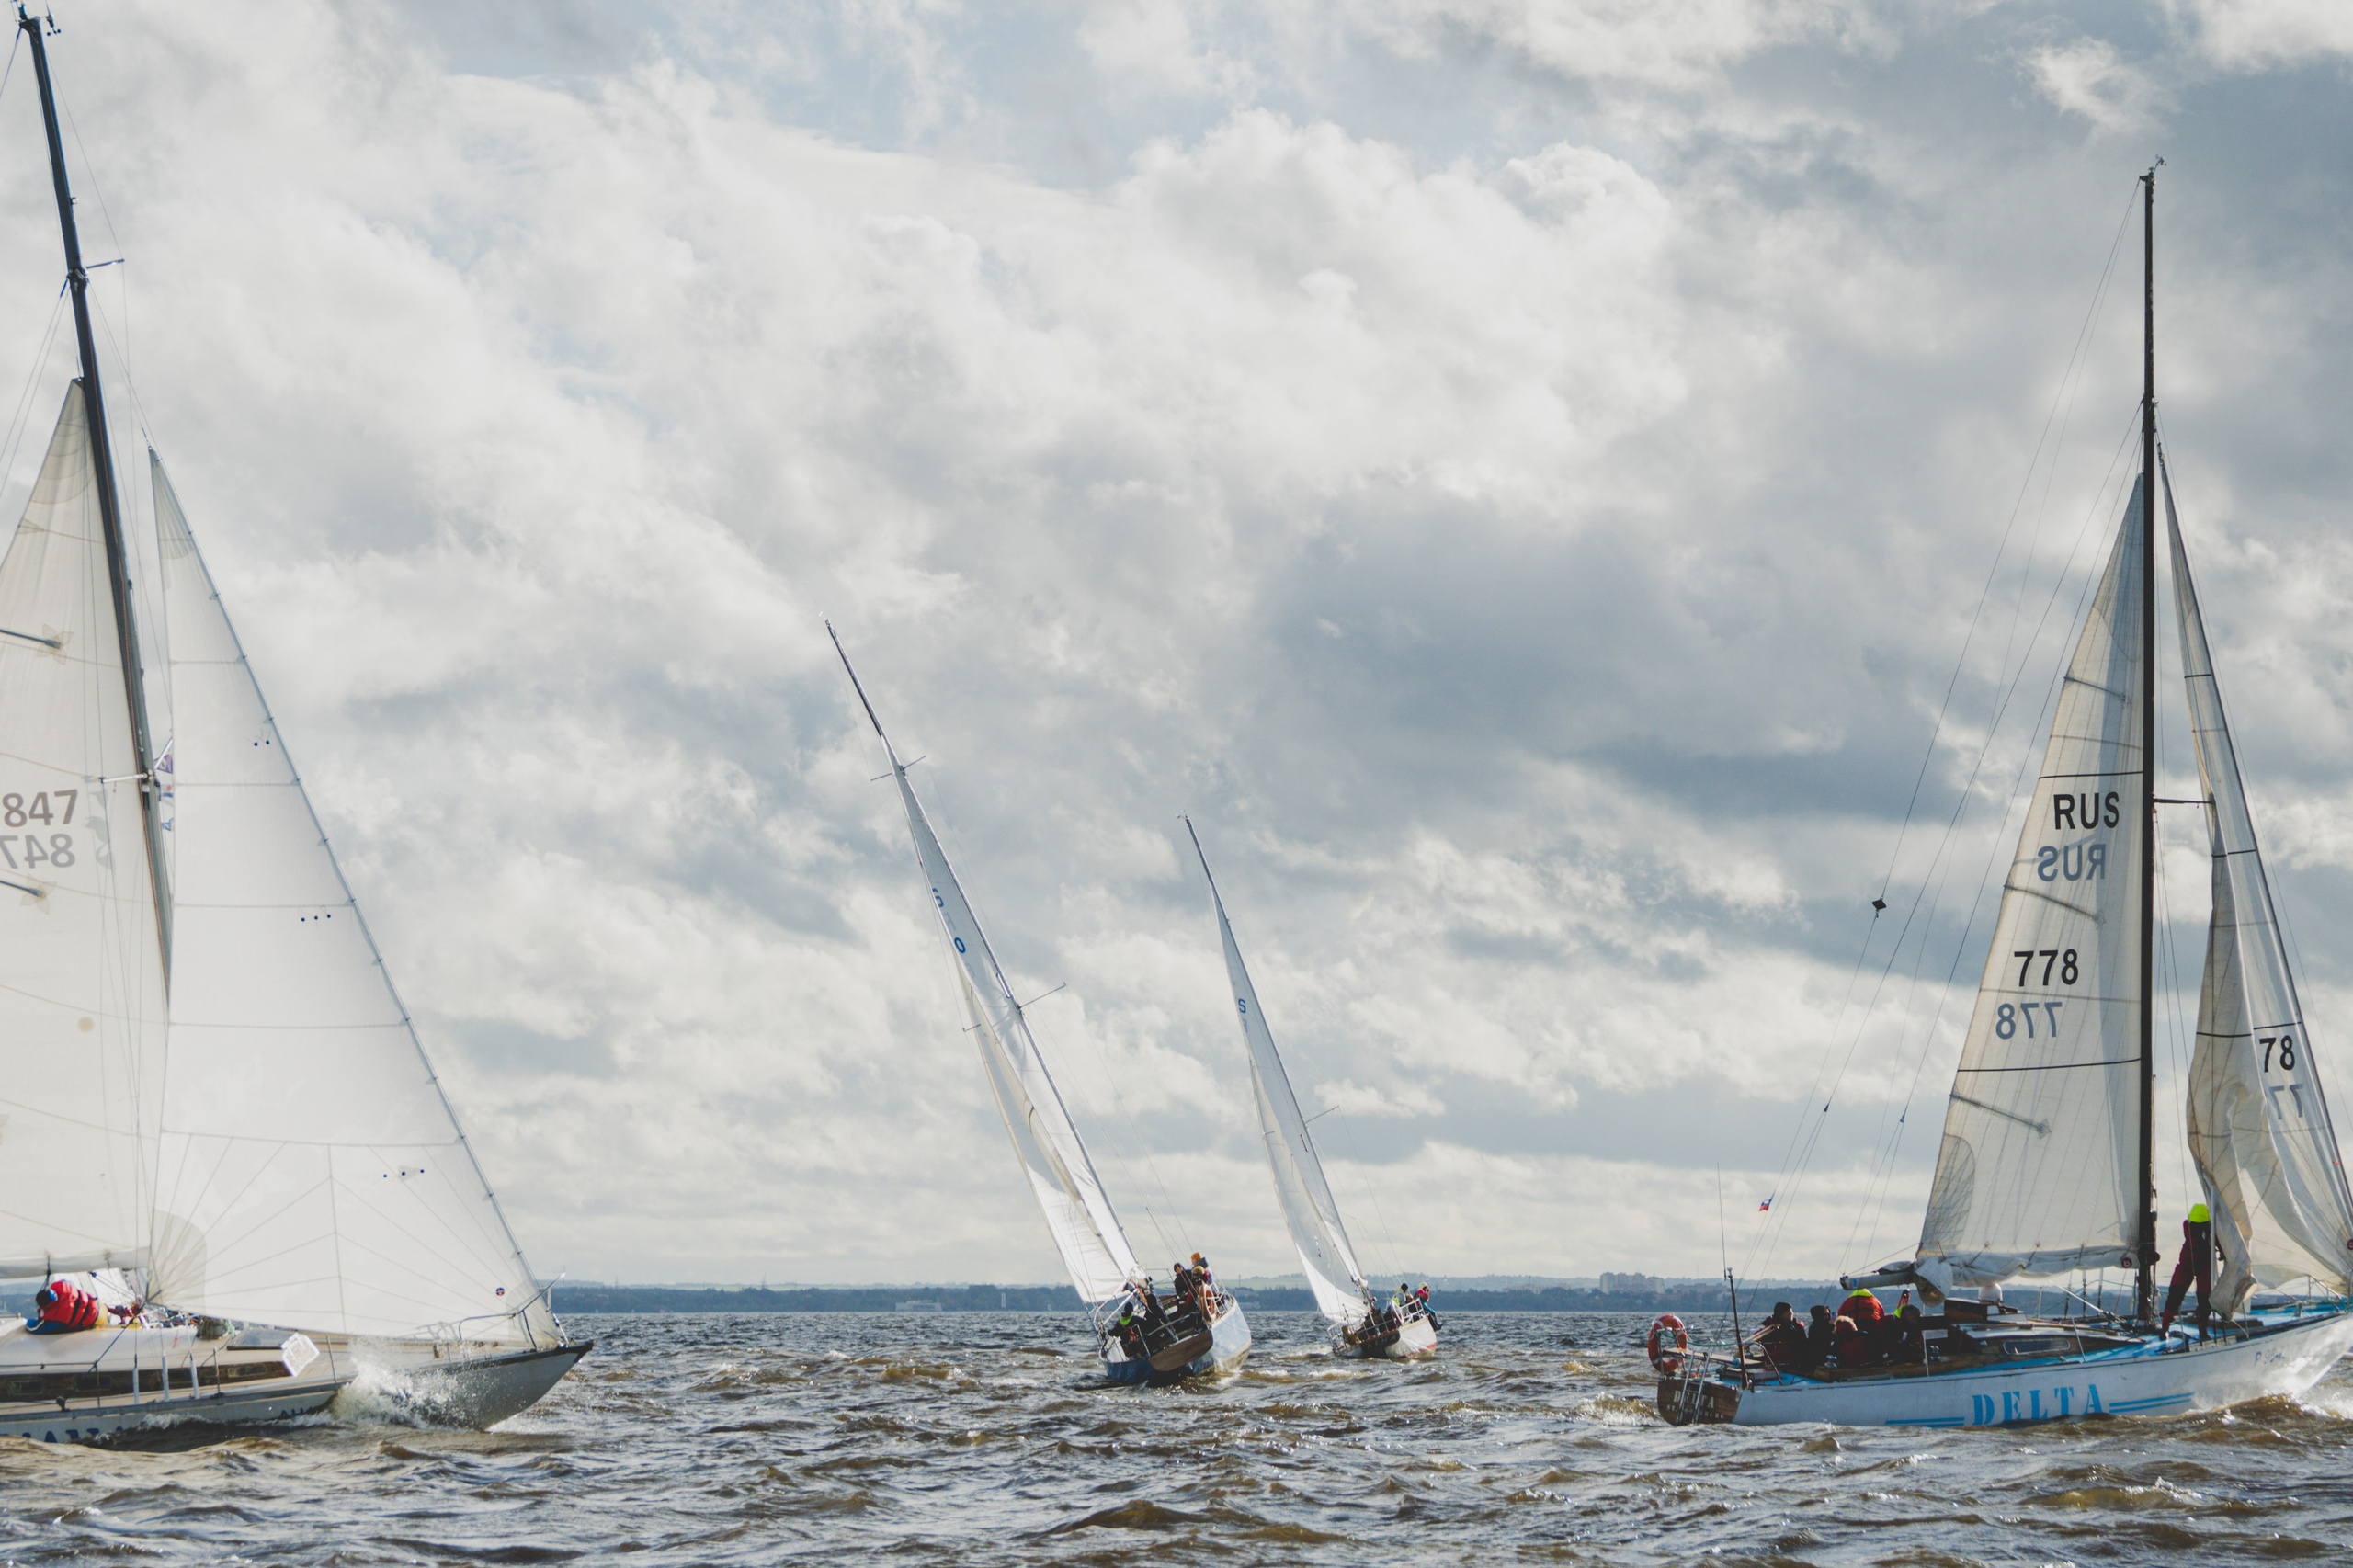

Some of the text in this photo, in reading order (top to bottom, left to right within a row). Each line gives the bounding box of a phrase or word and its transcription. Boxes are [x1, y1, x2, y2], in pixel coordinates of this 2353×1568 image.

[2, 789, 78, 828] 847
[2053, 791, 2120, 830] RUS
[2014, 949, 2079, 987] 778
[1972, 1383, 2103, 1426] DELTA
